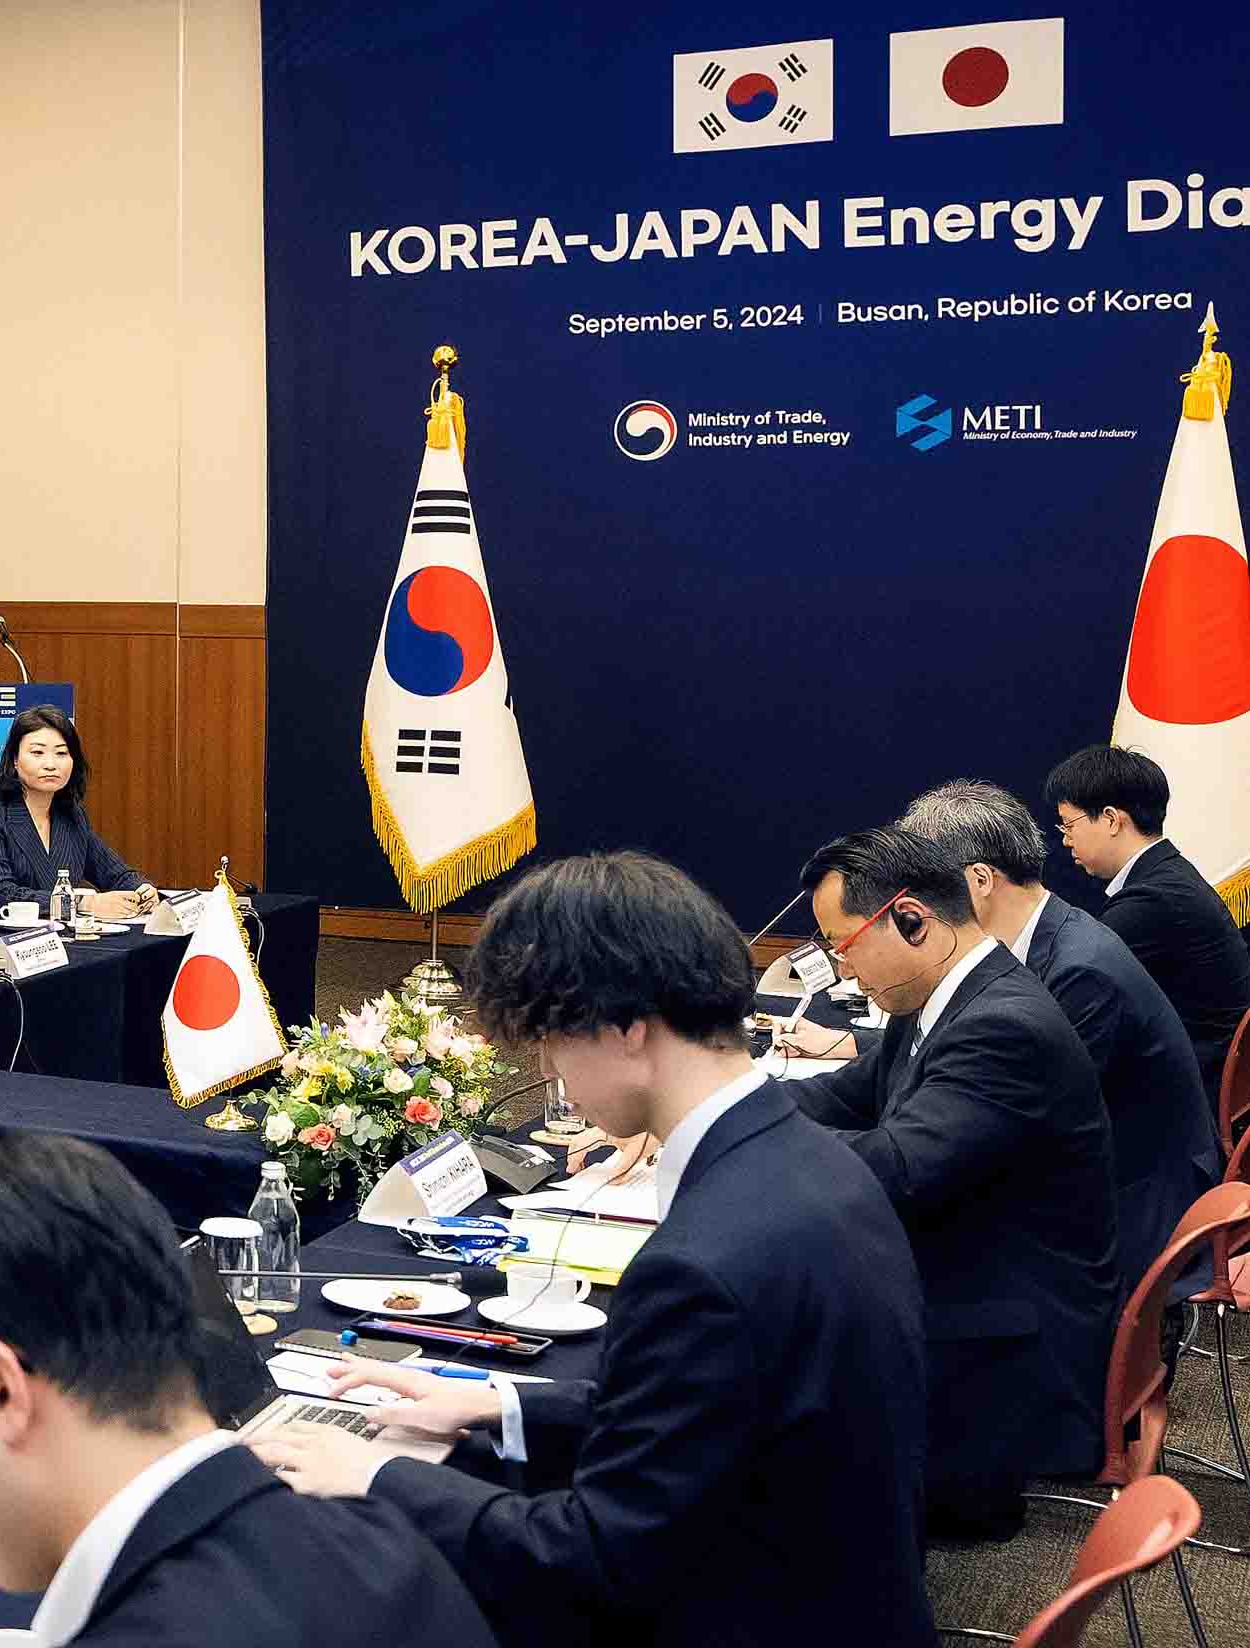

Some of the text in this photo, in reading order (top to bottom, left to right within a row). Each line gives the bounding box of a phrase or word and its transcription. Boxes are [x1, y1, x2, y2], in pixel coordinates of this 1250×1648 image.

[350, 173, 1250, 277] KOREA-JAPAN Energy Dia
[837, 289, 1192, 323] Busan, Republic of Korea
[568, 304, 805, 338] September 5, 2024
[688, 409, 827, 429] Ministry of Trade,
[962, 404, 1042, 431] METI
[688, 429, 851, 449] Industry and Energy
[962, 431, 999, 441] Ministry
[1000, 430, 1011, 440] of
[1054, 429, 1079, 439] Trade
[1079, 429, 1098, 439] and
[1098, 428, 1138, 440] Industry
